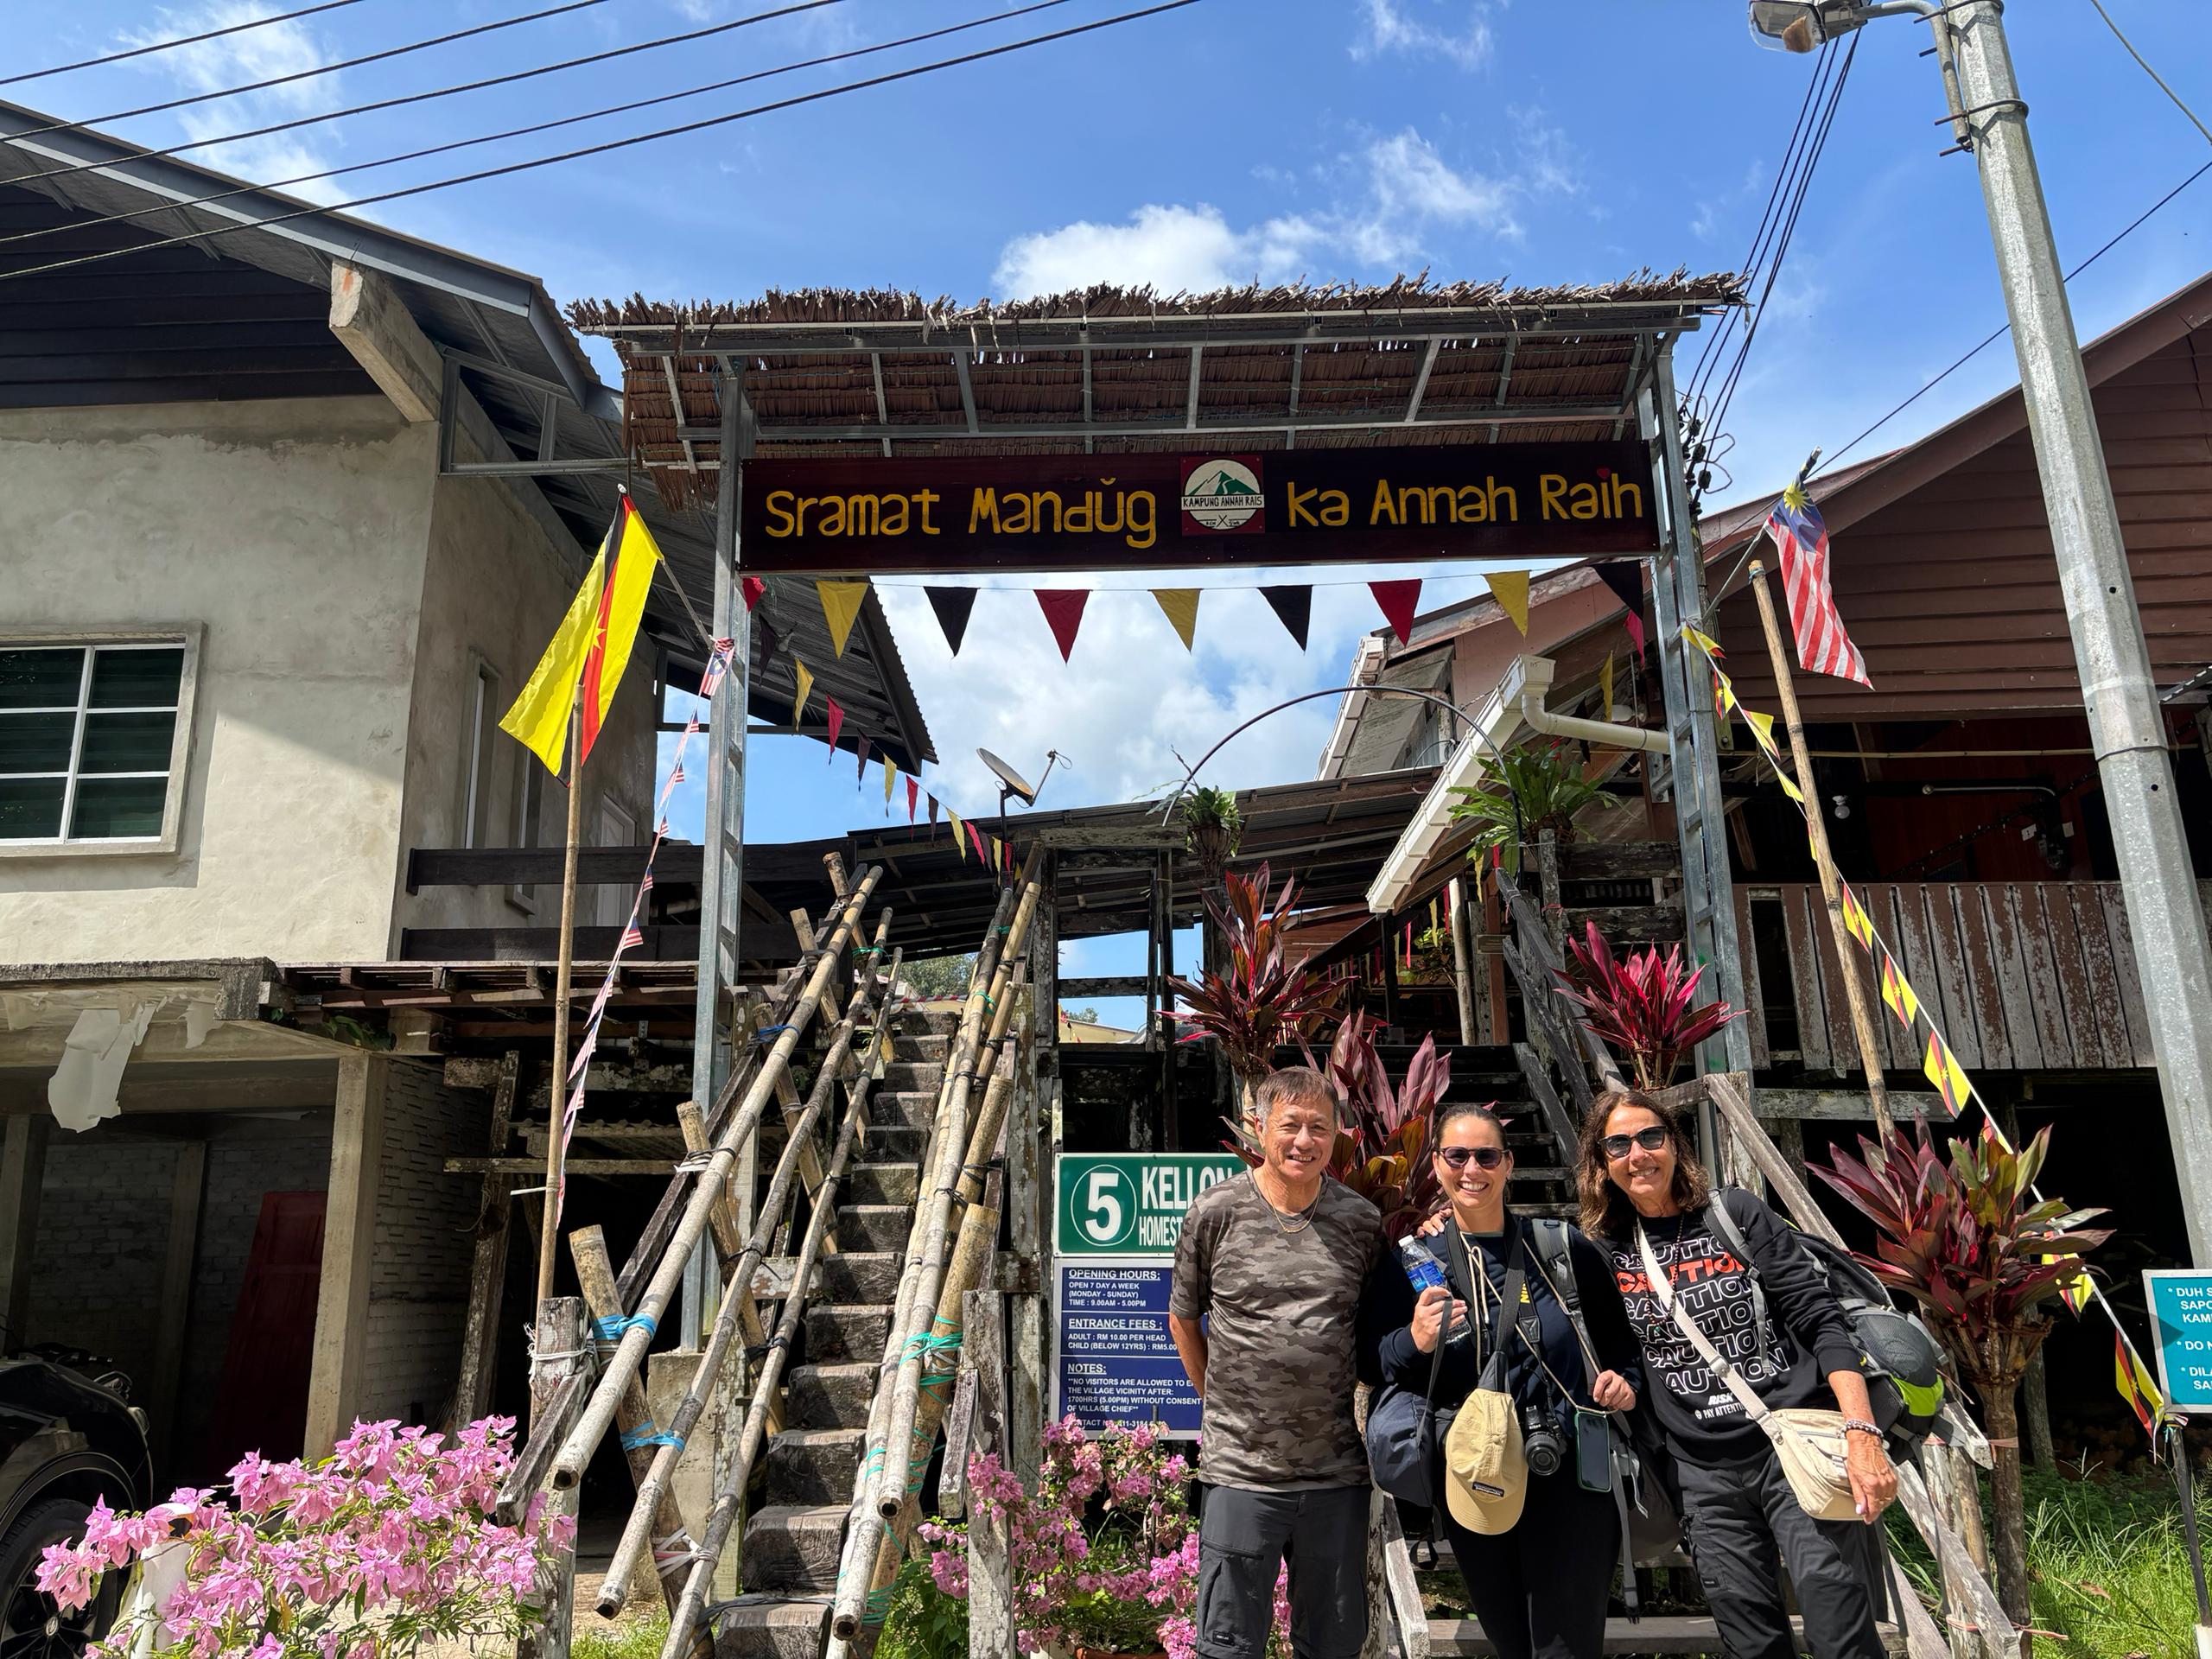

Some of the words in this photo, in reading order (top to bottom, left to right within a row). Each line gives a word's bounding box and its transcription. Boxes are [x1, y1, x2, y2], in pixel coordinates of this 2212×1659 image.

[1183, 498, 1219, 507] KAMPUNG
[1221, 497, 1243, 506] ANNAH
[1245, 496, 1262, 505] RAIS
[1370, 475, 1518, 524] Annah
[1540, 468, 1643, 520] Raih
[766, 488, 941, 537] Sramat
[1084, 1173, 1122, 1241] 5
[1069, 1270, 1116, 1279] OPENING
[1120, 1271, 1160, 1280] HOURS:
[2176, 1287, 2203, 1297] DUH
[1069, 1319, 1126, 1328] ENTRANCE
[1128, 1319, 1156, 1329] FEES
[2184, 1341, 2204, 1351] DO
[1068, 1363, 1106, 1374] NOTES:
[1703, 1408, 1716, 1419] PAY
